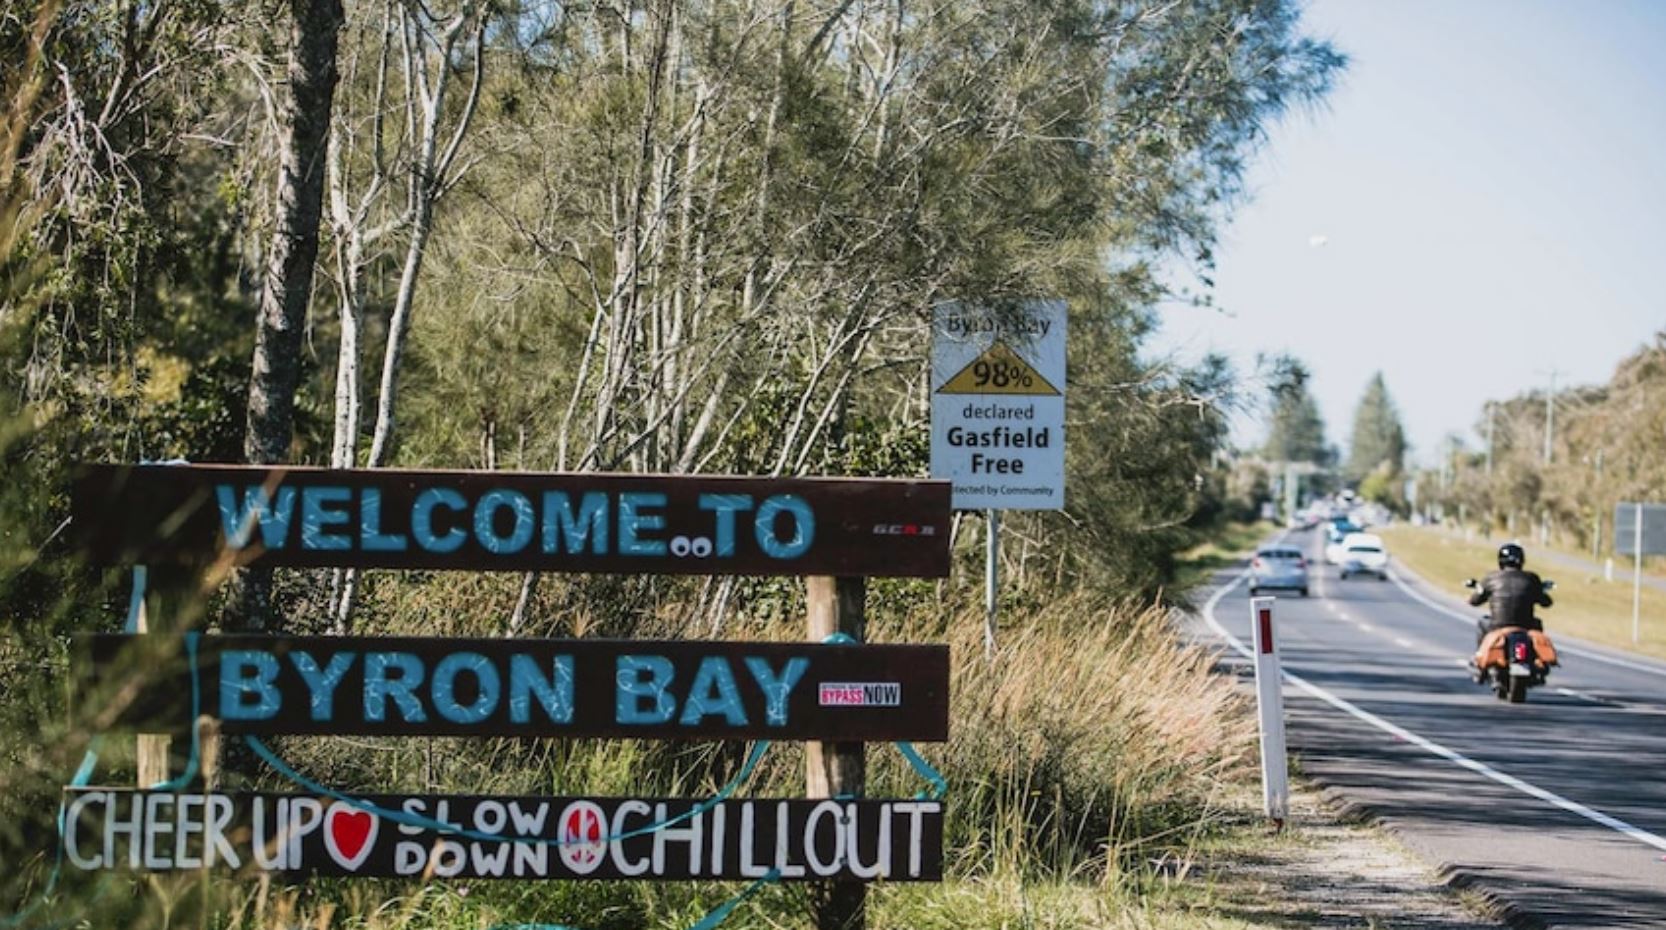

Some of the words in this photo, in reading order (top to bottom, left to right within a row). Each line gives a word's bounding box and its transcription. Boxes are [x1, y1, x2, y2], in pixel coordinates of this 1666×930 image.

[973, 360, 1033, 388] 98%
[963, 404, 1035, 420] declared
[947, 427, 1049, 449] Gasfield
[972, 454, 1024, 475] Free
[987, 484, 998, 497] by
[1001, 484, 1054, 497] Community
[216, 485, 668, 557] WELCOME
[700, 494, 816, 560] TO
[219, 649, 575, 725] BYRON
[616, 654, 811, 727] BAY
[64, 792, 242, 871] CHEER
[252, 796, 324, 871] UP
[398, 798, 549, 836] SLOW
[394, 840, 549, 877] DOWN
